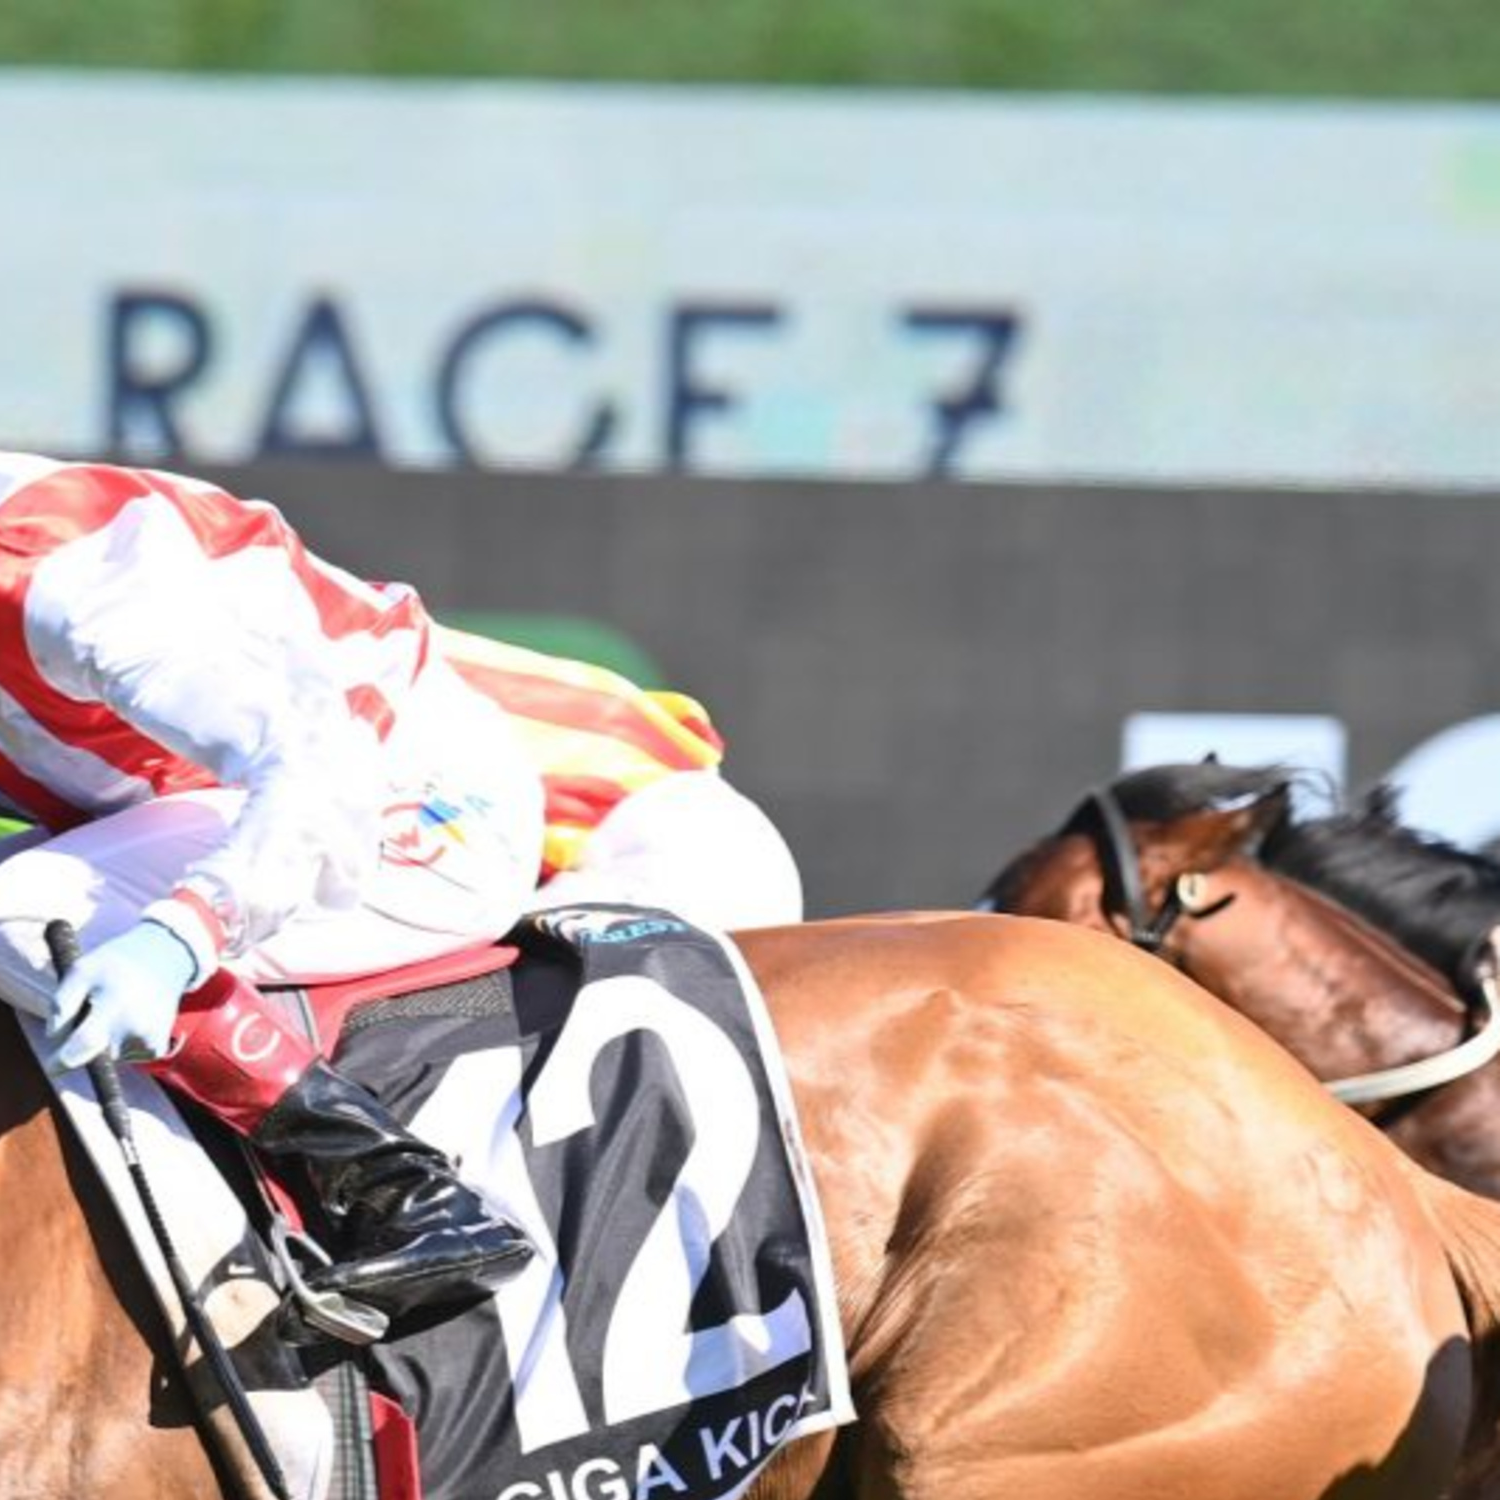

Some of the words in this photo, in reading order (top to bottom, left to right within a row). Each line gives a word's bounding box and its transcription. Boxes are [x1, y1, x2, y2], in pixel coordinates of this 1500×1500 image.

[894, 306, 1024, 480] 7
[407, 975, 812, 1455] 12
[699, 1385, 816, 1481] KIC
